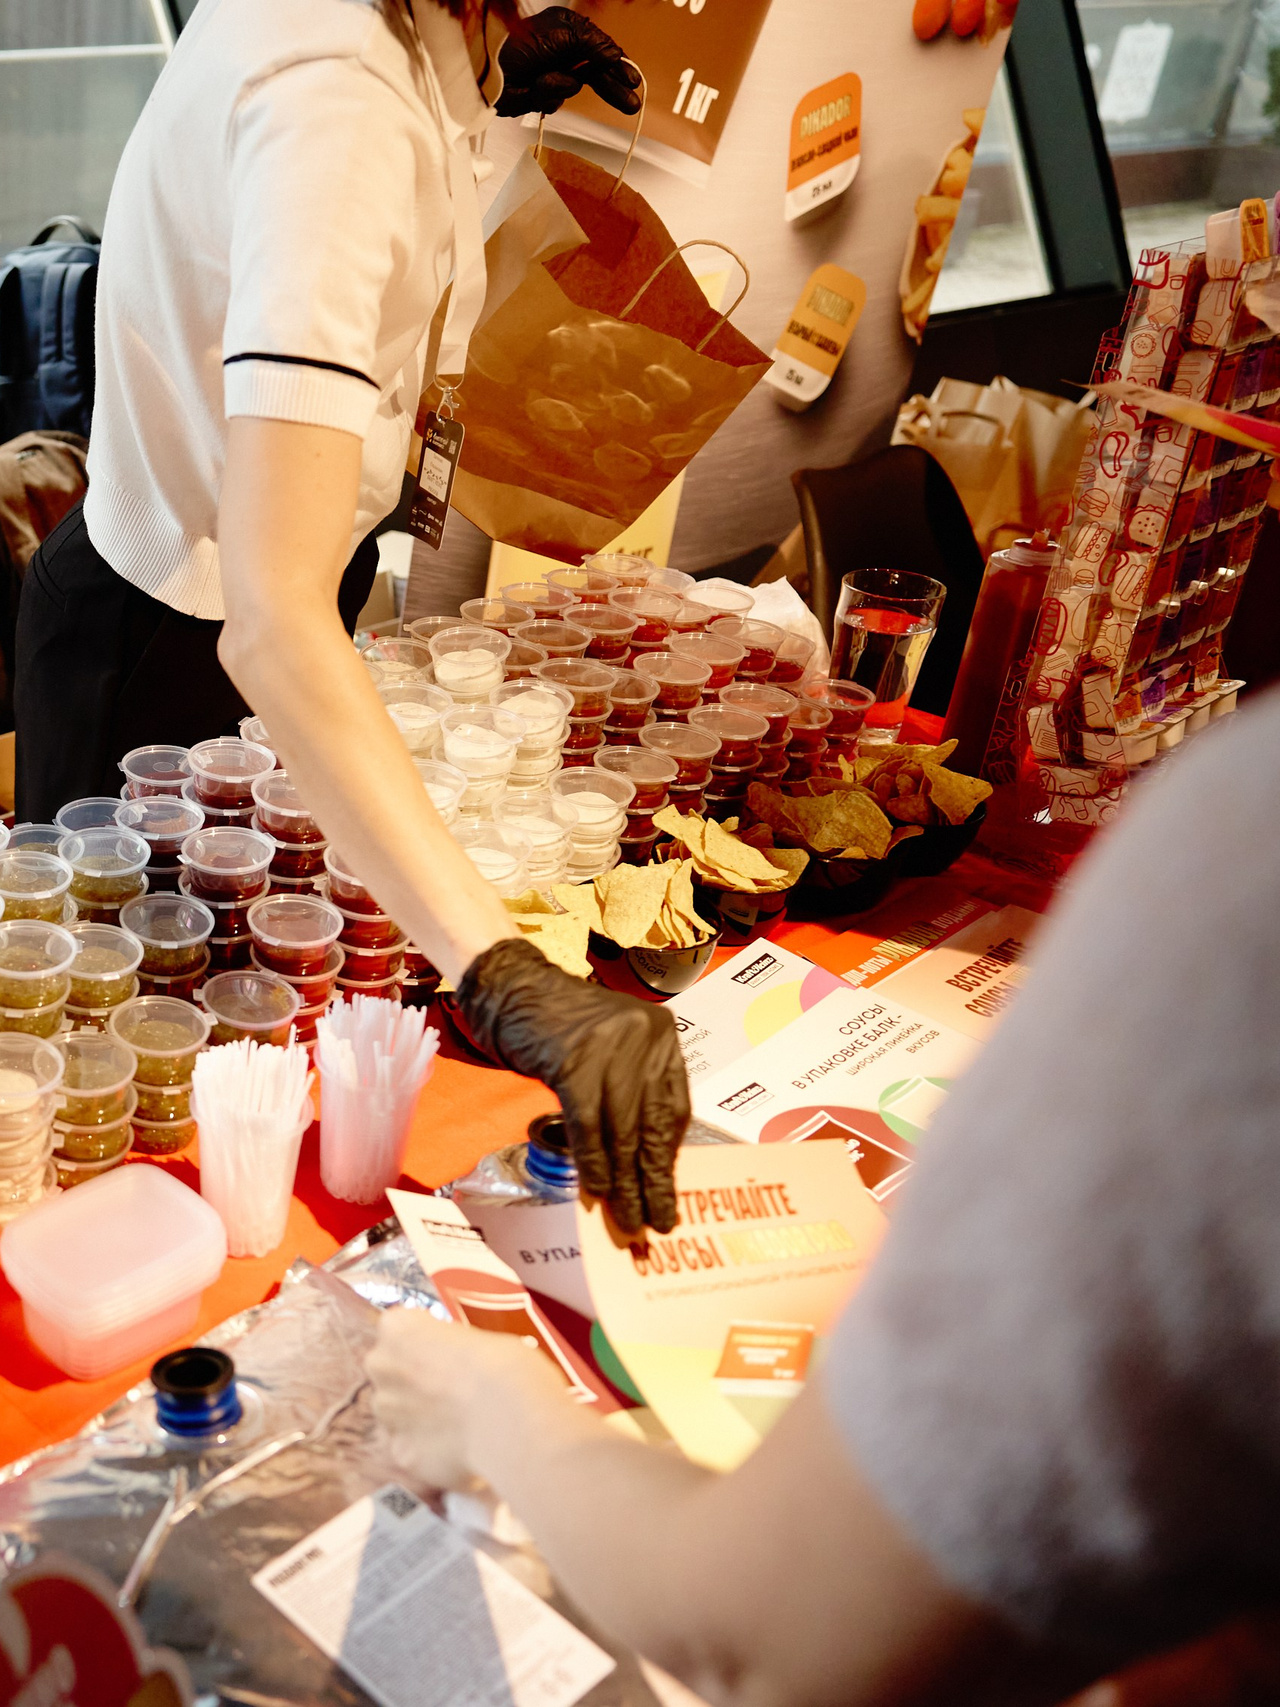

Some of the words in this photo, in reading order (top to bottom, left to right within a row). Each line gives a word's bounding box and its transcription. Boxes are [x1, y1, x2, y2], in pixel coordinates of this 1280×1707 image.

[672, 68, 695, 114] 1
[838, 1003, 887, 1036] СОУСЫ
[905, 1029, 941, 1054] ВКУСОВ
[791, 1080, 807, 1090] В
[800, 1038, 869, 1083] УПАКОВКЕ
[845, 1045, 889, 1076] ШИРОКАЯ
[884, 1022, 924, 1049] ЛИНЕЙКА
[676, 1178, 798, 1226] ТРЕЧАЙТЕ
